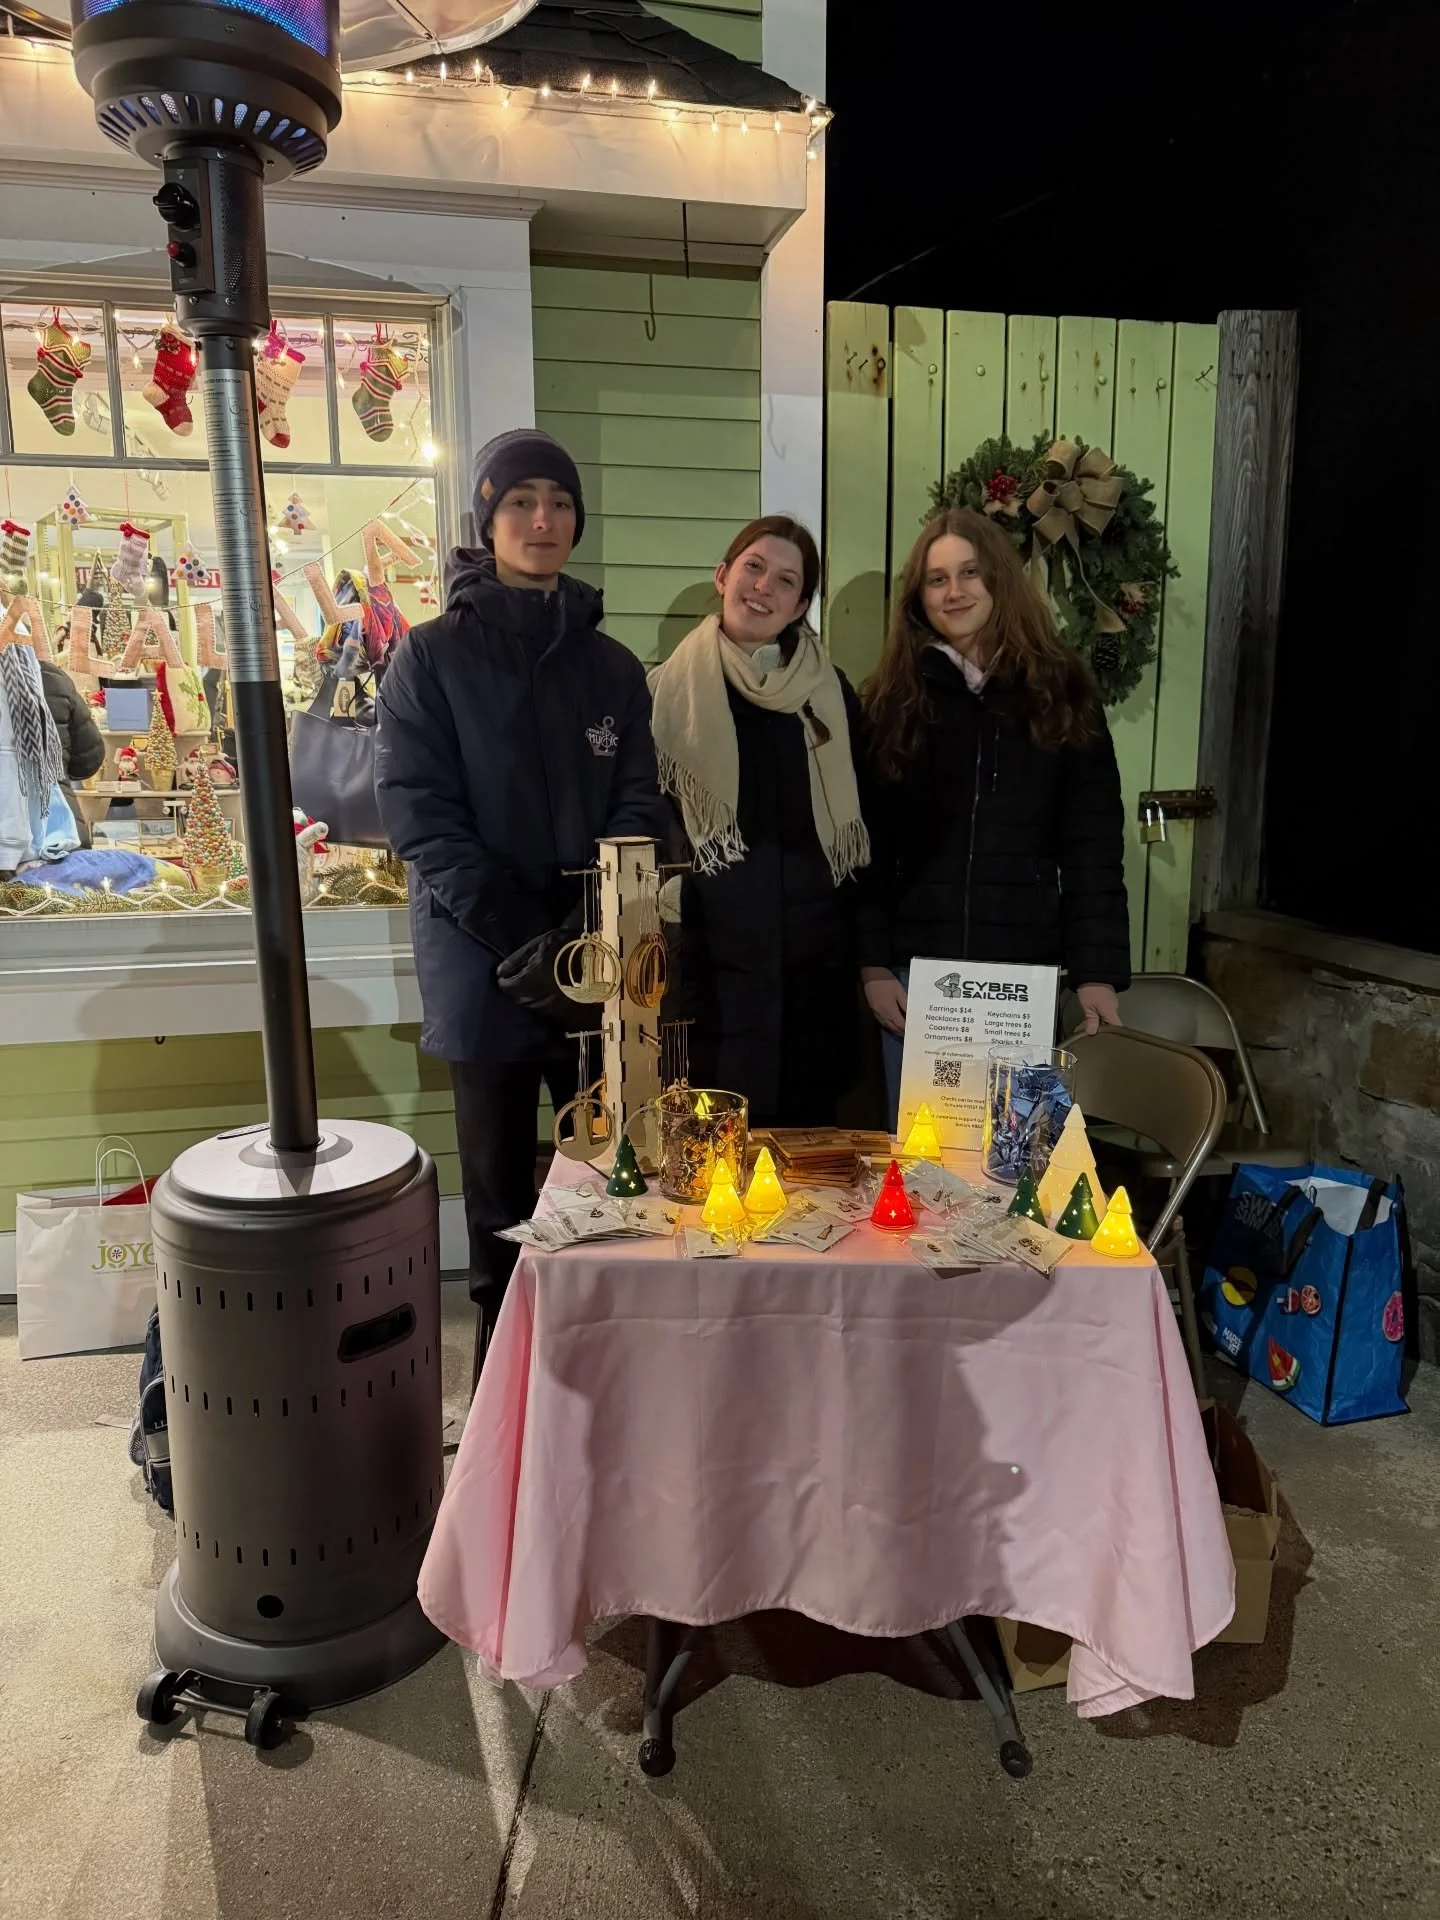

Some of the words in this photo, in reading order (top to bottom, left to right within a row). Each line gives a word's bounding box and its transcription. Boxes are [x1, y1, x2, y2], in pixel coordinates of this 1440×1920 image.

[962, 980, 1029, 994] CYBER
[962, 990, 1029, 1002] SAILORS
[929, 1004, 958, 1014] Earrings
[960, 1006, 972, 1014] $14
[925, 1014, 961, 1023] Necklaces
[962, 1016, 975, 1024] $18
[987, 1010, 1021, 1020] Keychains
[928, 1023, 960, 1032] Coasters
[984, 1019, 1004, 1028] Large
[923, 1032, 963, 1042] Ornaments
[984, 1028, 1003, 1036] Small
